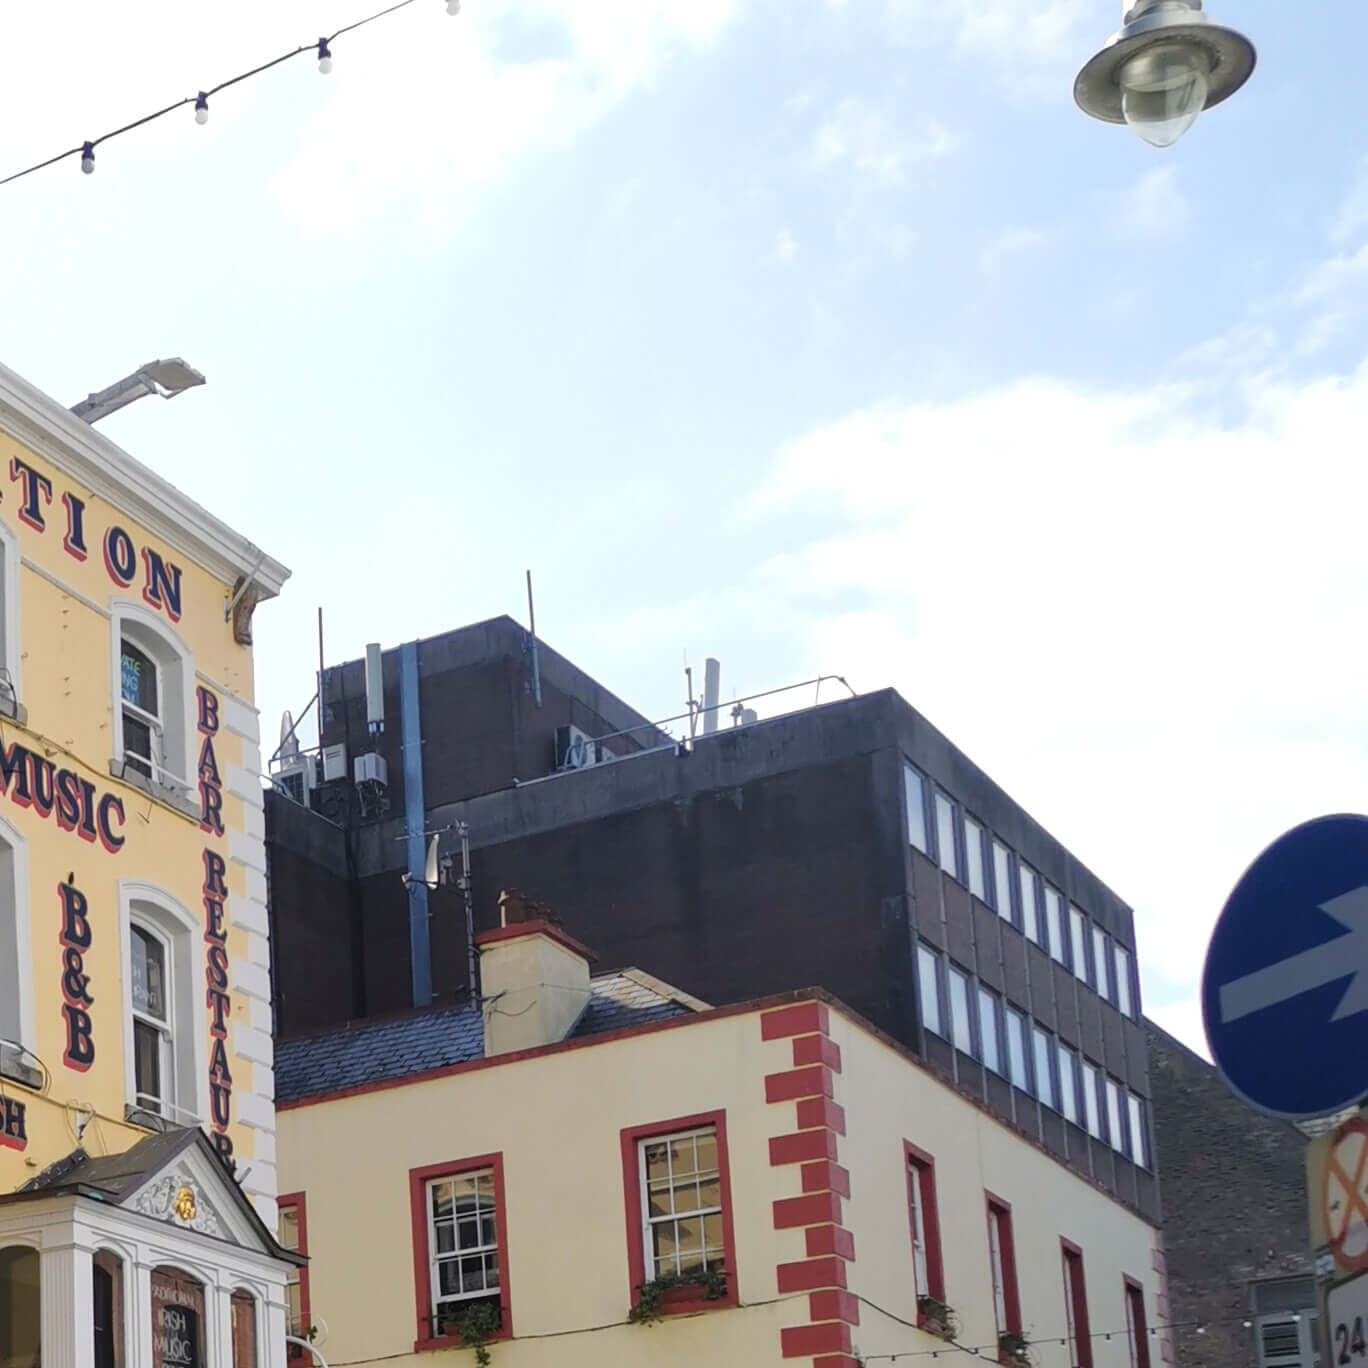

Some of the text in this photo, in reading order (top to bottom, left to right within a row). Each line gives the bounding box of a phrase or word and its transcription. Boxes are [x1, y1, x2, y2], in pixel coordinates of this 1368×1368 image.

[58, 881, 95, 1072] B&B
[196, 685, 236, 1172] BAR RESTAUR
